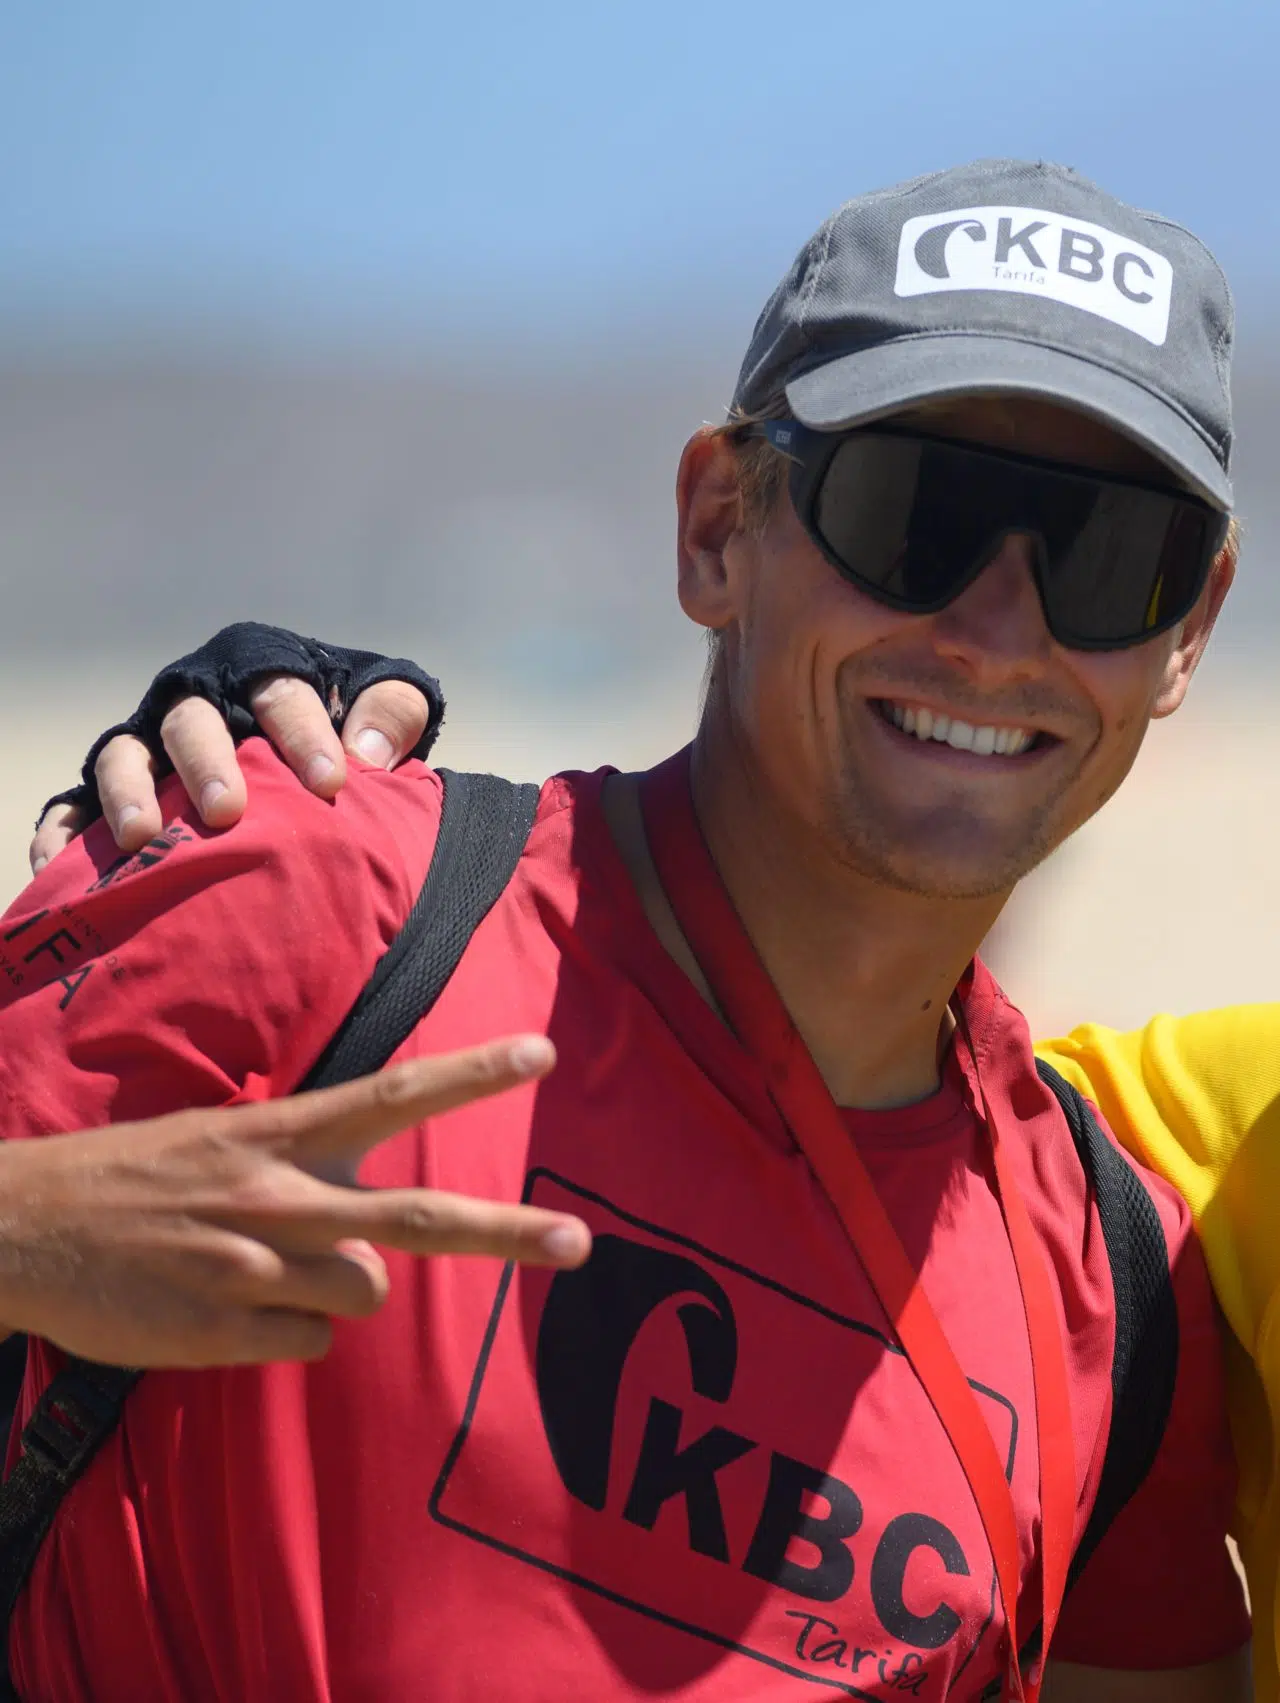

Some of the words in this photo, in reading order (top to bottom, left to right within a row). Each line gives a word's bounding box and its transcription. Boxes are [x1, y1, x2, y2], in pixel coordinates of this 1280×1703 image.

[992, 265, 1046, 285] Tarifa
[994, 217, 1155, 304] KBC
[622, 1395, 971, 1650] KBC
[785, 1610, 929, 1697] Tarifa
